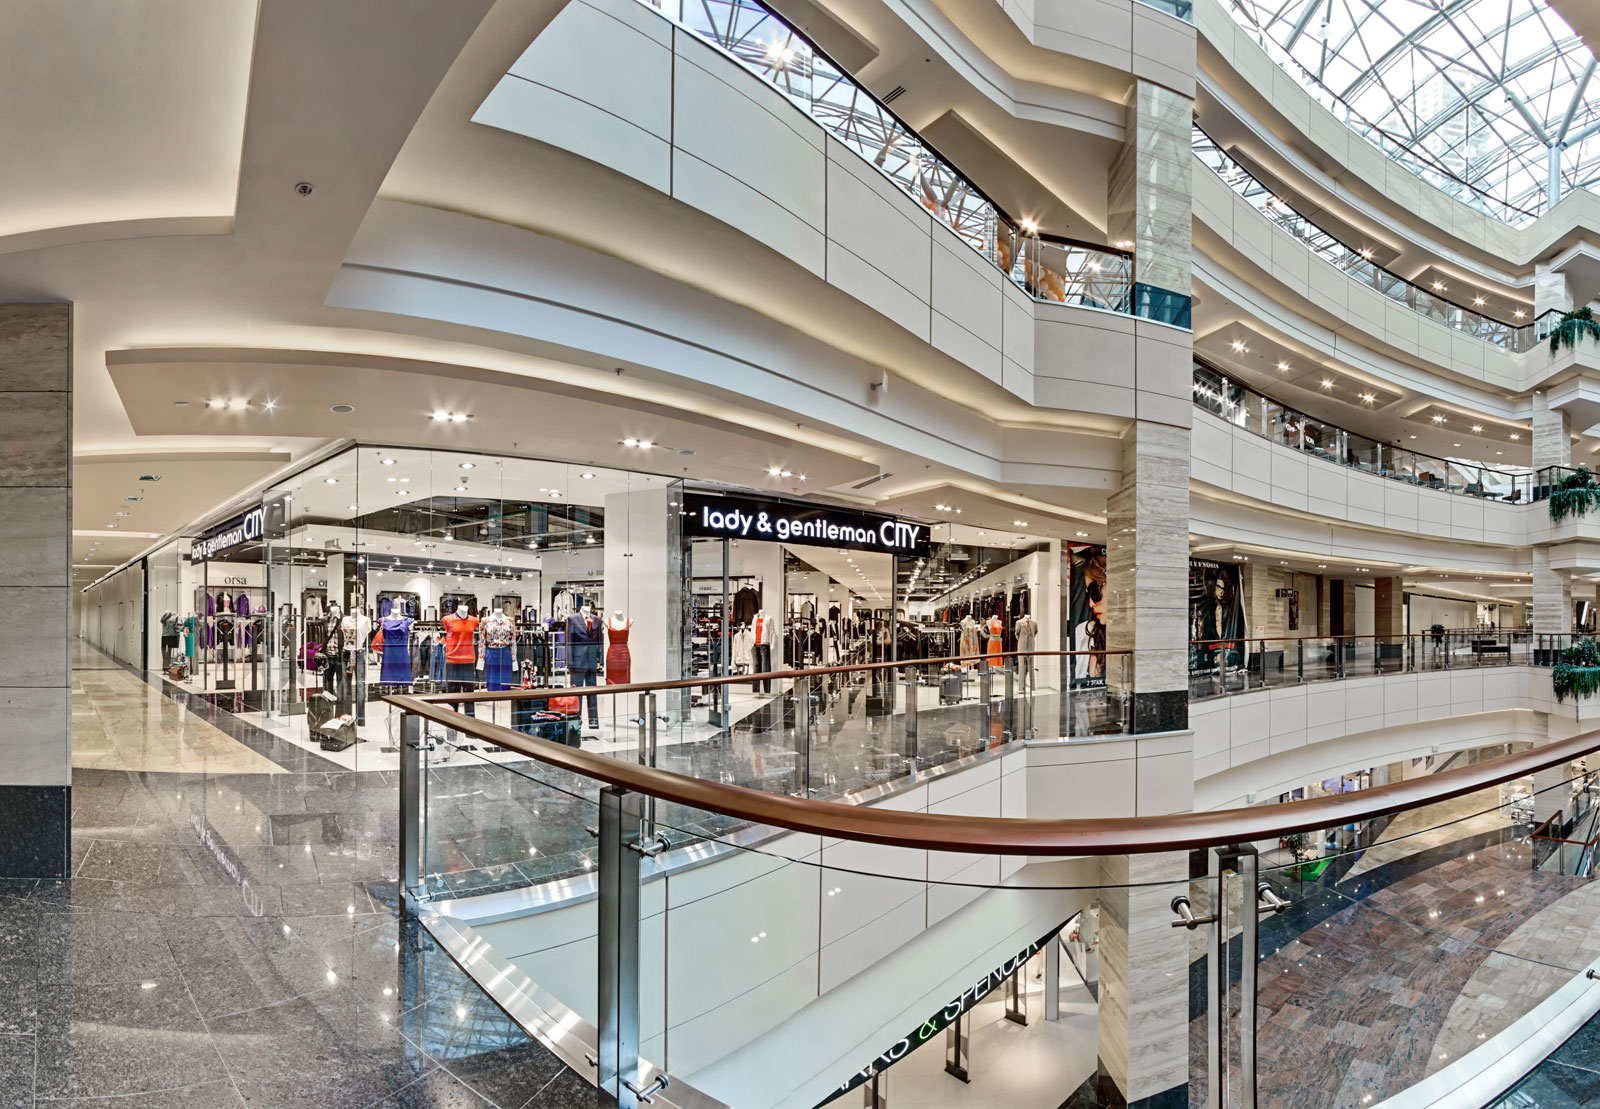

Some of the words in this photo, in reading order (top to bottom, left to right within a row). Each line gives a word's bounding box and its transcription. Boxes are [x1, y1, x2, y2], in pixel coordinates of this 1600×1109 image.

[244, 506, 267, 540] CITY
[703, 506, 753, 536] lady
[757, 512, 772, 532] &
[776, 518, 876, 544] gentleman
[880, 521, 920, 549] CITY
[224, 576, 247, 585] orsa
